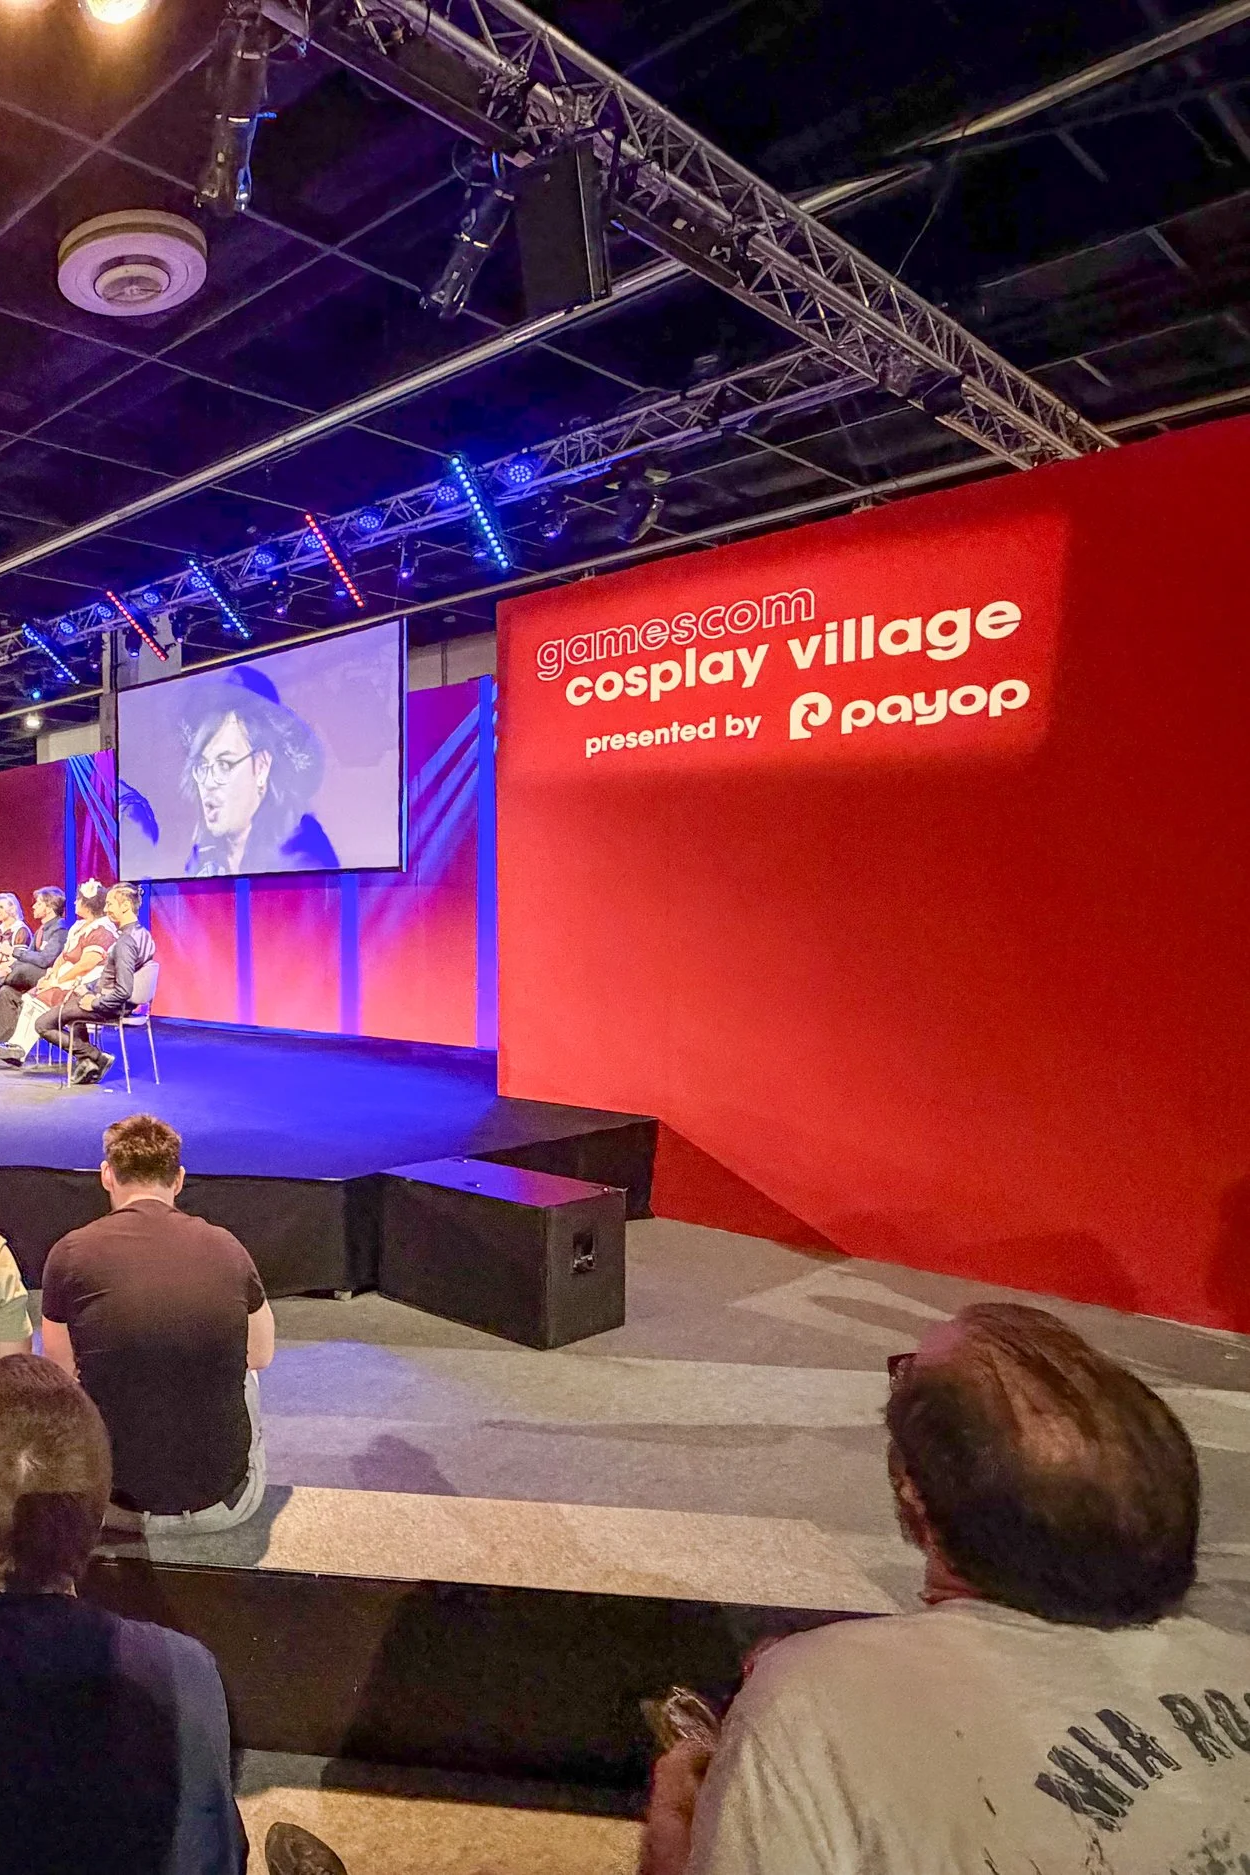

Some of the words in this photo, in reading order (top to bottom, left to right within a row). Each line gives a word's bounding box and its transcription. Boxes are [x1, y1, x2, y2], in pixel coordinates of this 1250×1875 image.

[536, 587, 816, 680] gamescom
[565, 641, 770, 706] cosplay
[786, 600, 1023, 670] village
[585, 716, 717, 758] presented
[725, 713, 762, 739] by
[840, 679, 1031, 734] payop
